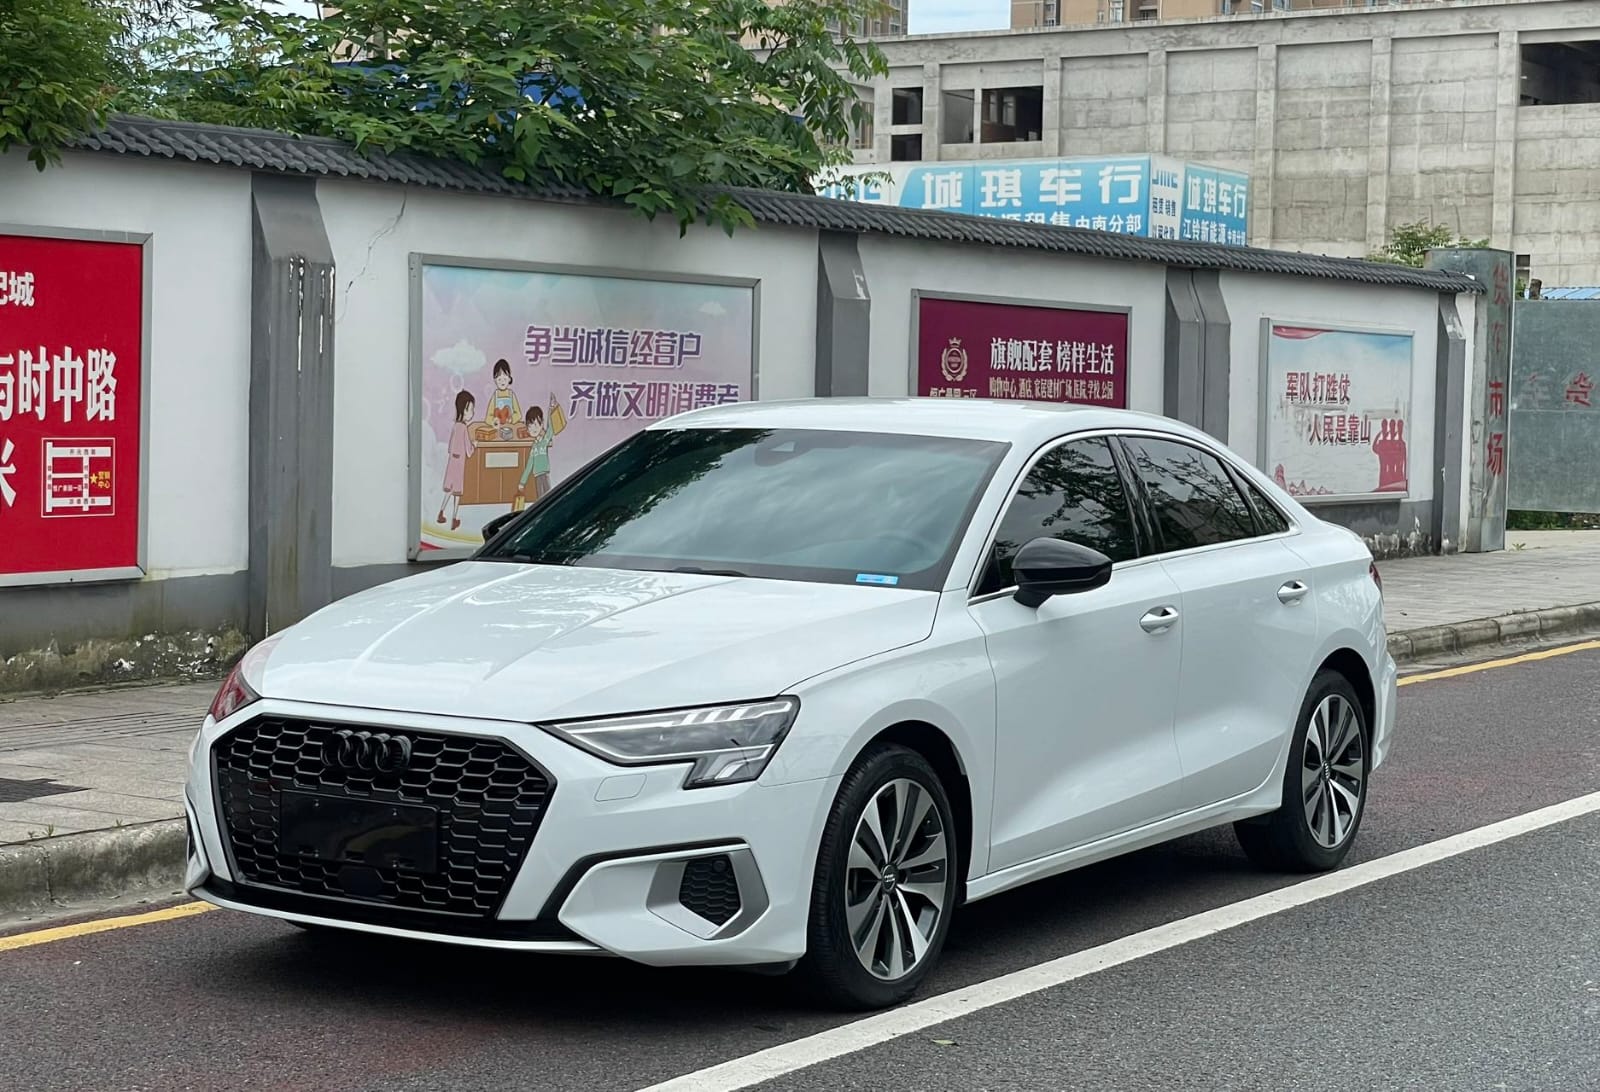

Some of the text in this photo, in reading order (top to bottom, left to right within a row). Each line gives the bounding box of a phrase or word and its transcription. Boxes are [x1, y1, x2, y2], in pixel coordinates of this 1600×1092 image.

[922, 165, 1142, 209] 城琪车行
[1186, 174, 1247, 219] 城琪车行
[525, 325, 702, 368] 争当诚信经营户
[990, 336, 1114, 375] 旗舰配套 榜样生活
[569, 381, 740, 418] 齐做文明消费者
[1286, 371, 1351, 404] 军队打胜仗
[1309, 412, 1372, 446] 人民是靠山
